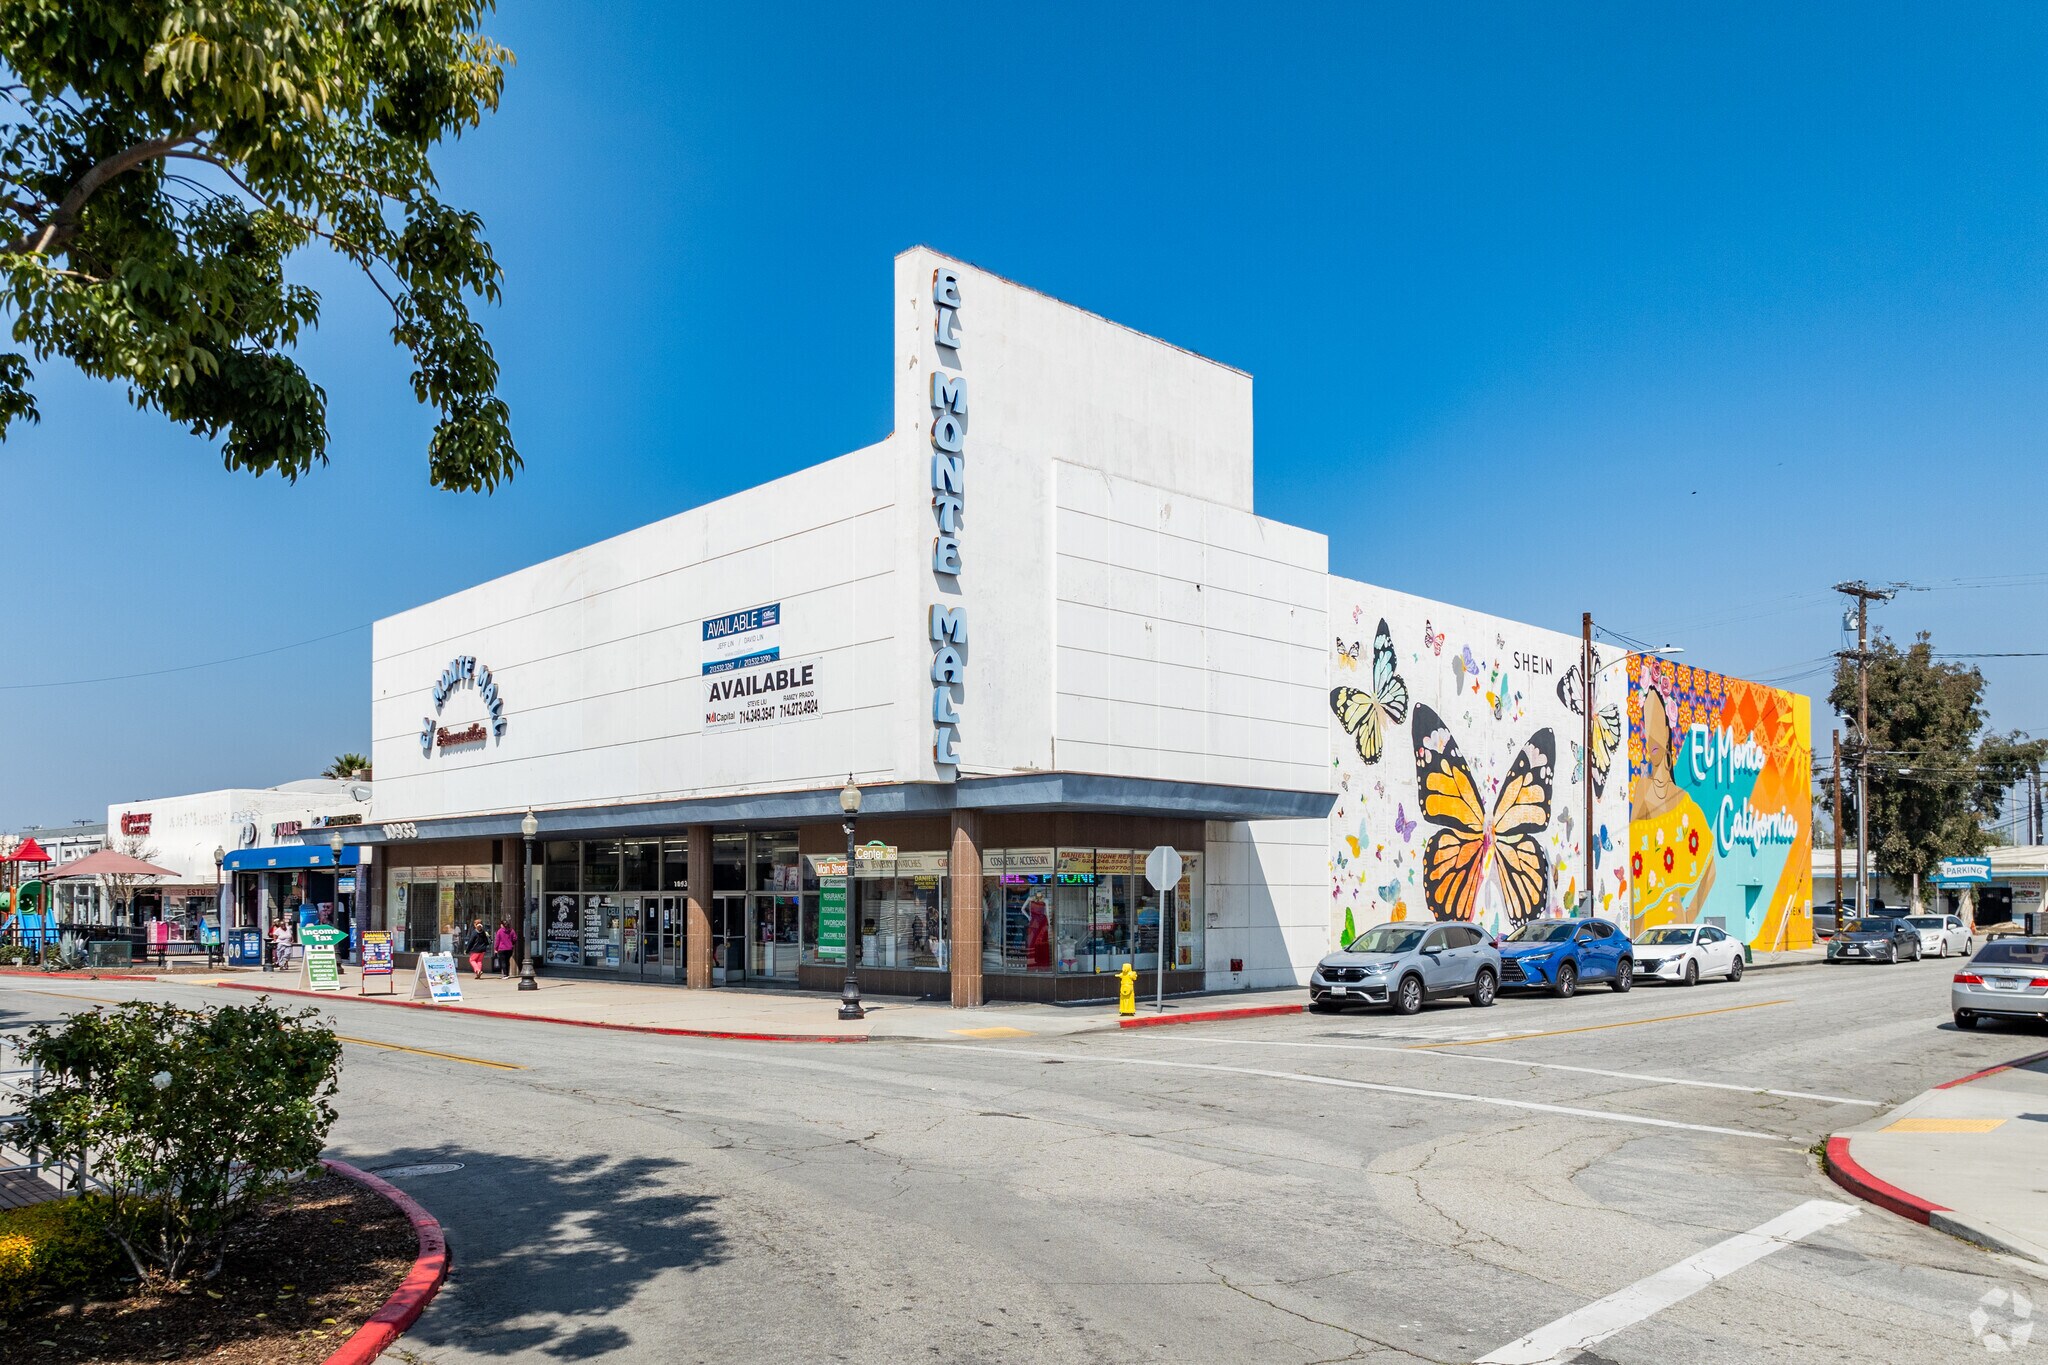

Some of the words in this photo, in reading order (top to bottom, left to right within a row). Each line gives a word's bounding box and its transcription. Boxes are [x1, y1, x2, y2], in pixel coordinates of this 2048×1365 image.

[932, 267, 961, 349] EL
[930, 371, 968, 575] MONTE
[707, 611, 758, 639] AVAILABLE
[717, 642, 728, 650] JEFF
[743, 635, 756, 645] DAVID
[1513, 652, 1553, 675] SHEIN
[709, 664, 814, 703] AVAILABLE
[928, 603, 968, 764] MALL
[420, 717, 437, 749] EL
[432, 655, 477, 707] MONTE
[477, 665, 508, 737] MALL
[799, 691, 815, 699] PRADO
[716, 711, 736, 723] Capital
[780, 699, 818, 718] 714.273.4924
[747, 700, 760, 708] STEVE
[1691, 723, 1714, 781] El
[1716, 724, 1766, 784] Monte
[278, 821, 302, 836] NAILS
[382, 822, 418, 839] 10933
[1719, 795, 1797, 852] California
[856, 848, 884, 859] Center
[1020, 856, 1049, 865] ACCESSORY
[1061, 852, 1092, 860] DANIEL'S
[817, 864, 830, 874] Main
[831, 863, 847, 873] Street
[1946, 866, 1983, 875] PARKING
[302, 928, 340, 936] Income
